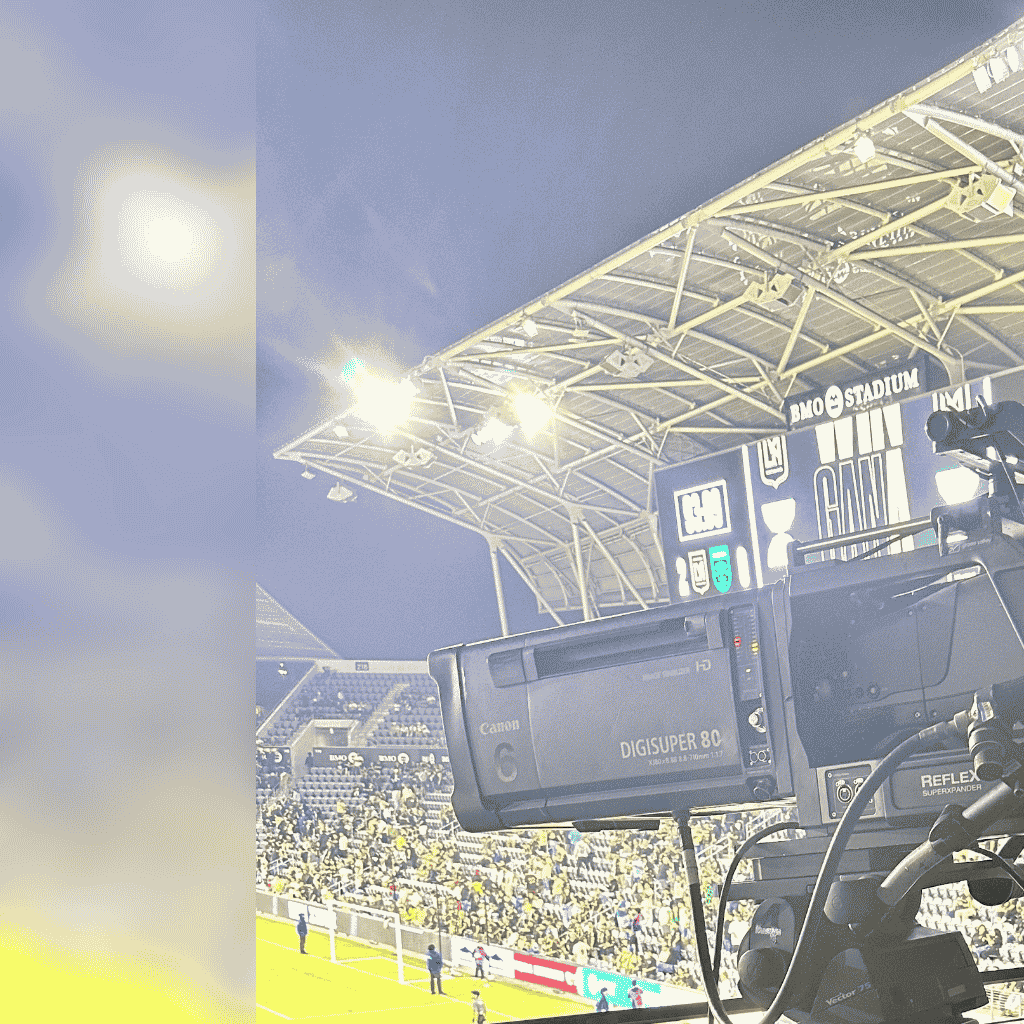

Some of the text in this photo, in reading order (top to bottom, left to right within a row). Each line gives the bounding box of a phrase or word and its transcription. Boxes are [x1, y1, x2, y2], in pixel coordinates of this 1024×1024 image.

[789, 396, 824, 425] BMO
[844, 367, 920, 408] STADIUM
[479, 719, 520, 735] Canon
[620, 728, 721, 759] DIGISUPER 80
[494, 742, 518, 783] 6
[920, 769, 981, 788] REFLEX
[922, 783, 982, 797] SUPERXPANDER
[825, 981, 872, 1006] Vector 75
